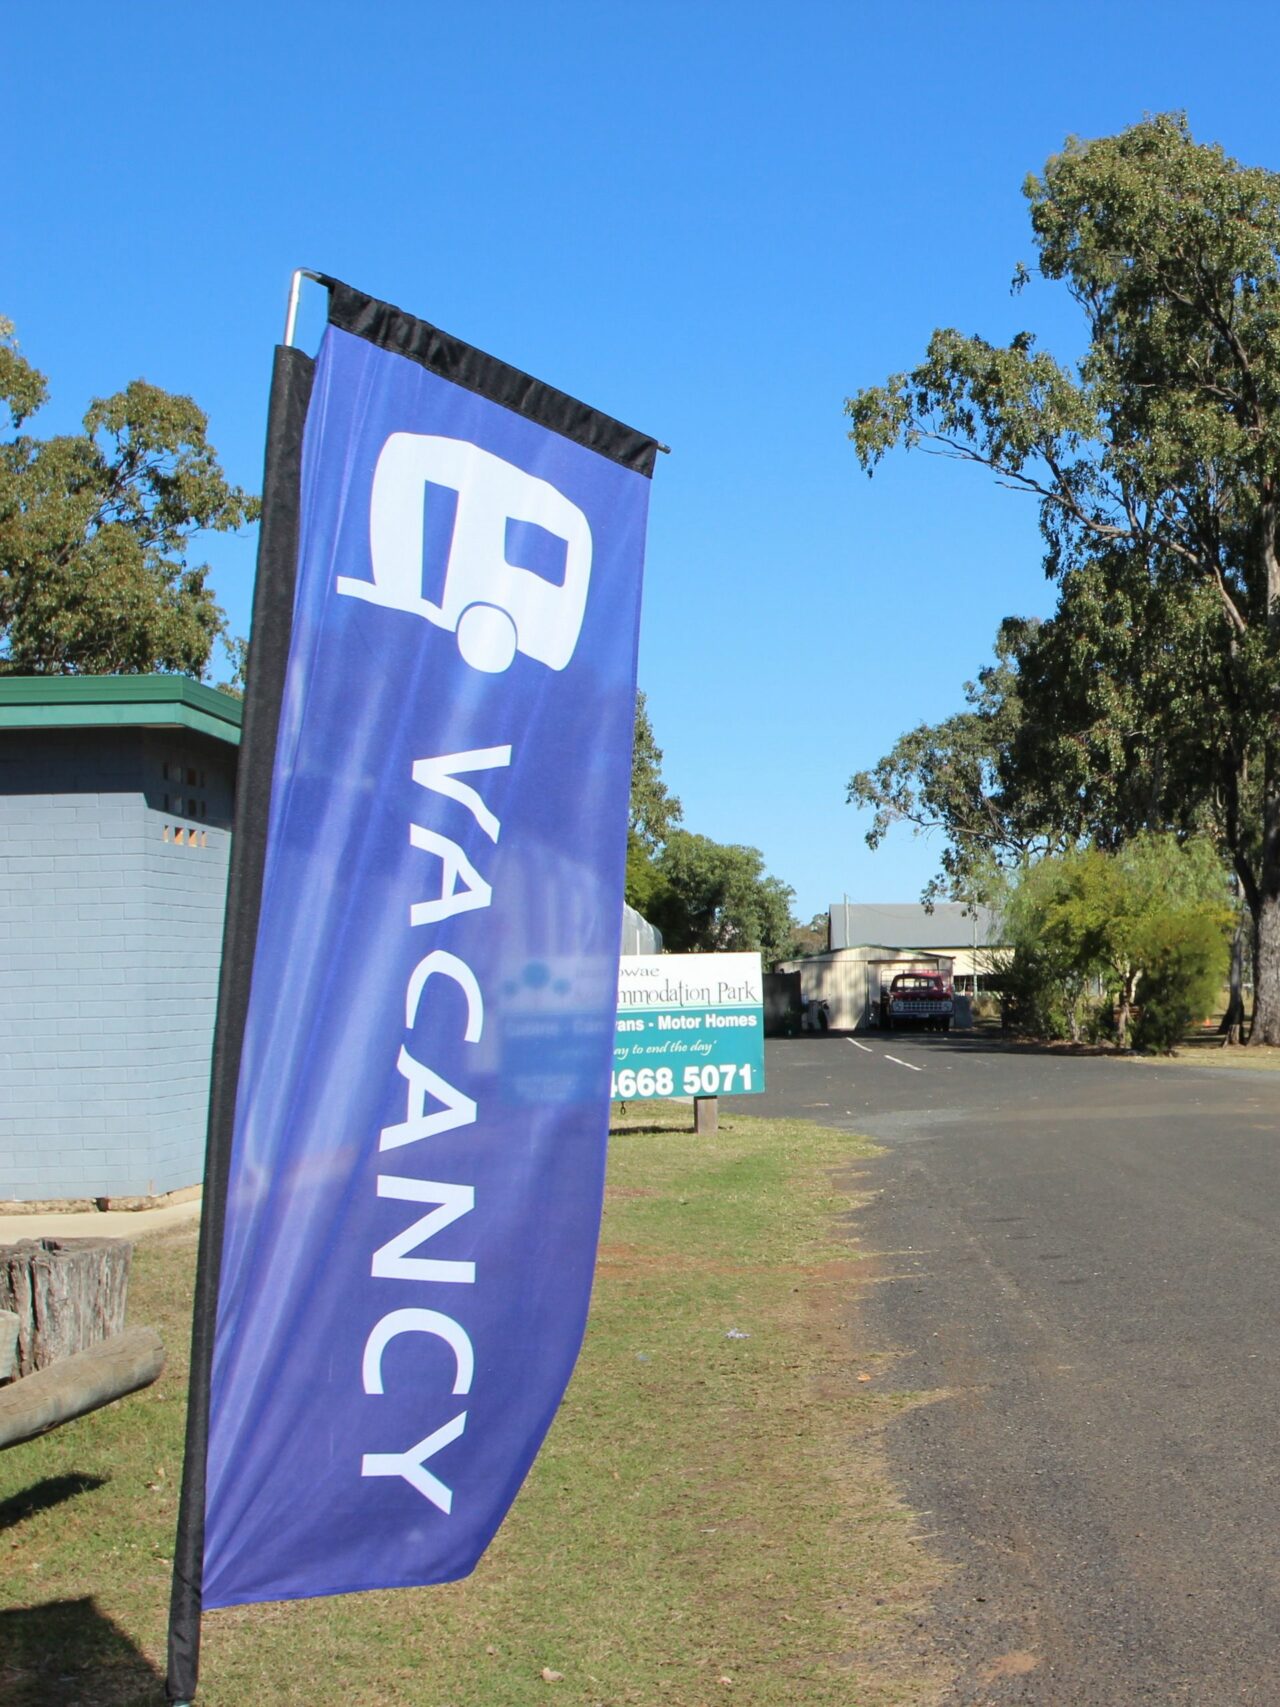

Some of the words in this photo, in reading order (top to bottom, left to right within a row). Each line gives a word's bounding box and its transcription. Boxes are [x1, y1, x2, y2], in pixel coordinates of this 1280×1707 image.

[617, 978, 712, 1007] mmodation
[717, 980, 759, 1004] Park
[616, 1019, 645, 1032] ans
[658, 1014, 702, 1031] Motor
[705, 1013, 757, 1028] Homes
[613, 1047, 629, 1060] ay
[632, 1044, 643, 1054] to
[646, 1041, 670, 1053] end
[670, 1040, 687, 1053] the
[683, 1063, 752, 1095] 5071
[360, 743, 513, 1515] VACANCY
